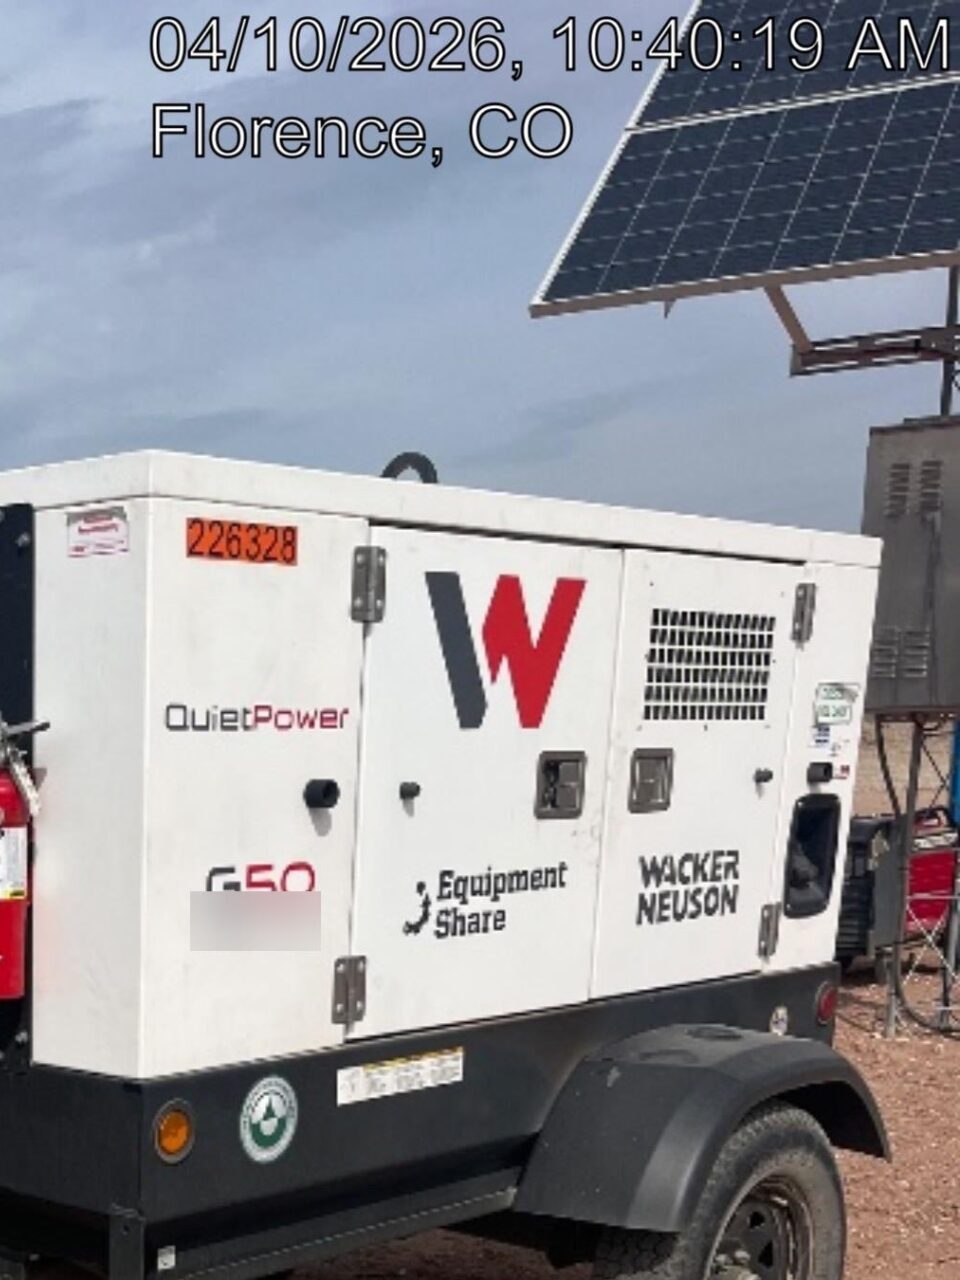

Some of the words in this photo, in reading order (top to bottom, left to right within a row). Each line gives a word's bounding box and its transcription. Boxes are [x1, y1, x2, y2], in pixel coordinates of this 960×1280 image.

[187, 518, 297, 564] 226328
[166, 704, 350, 732] QuietPower
[435, 862, 568, 902] Equipment
[639, 850, 739, 888] WACKER
[433, 906, 507, 938] Share
[636, 885, 738, 926] NEUSON
